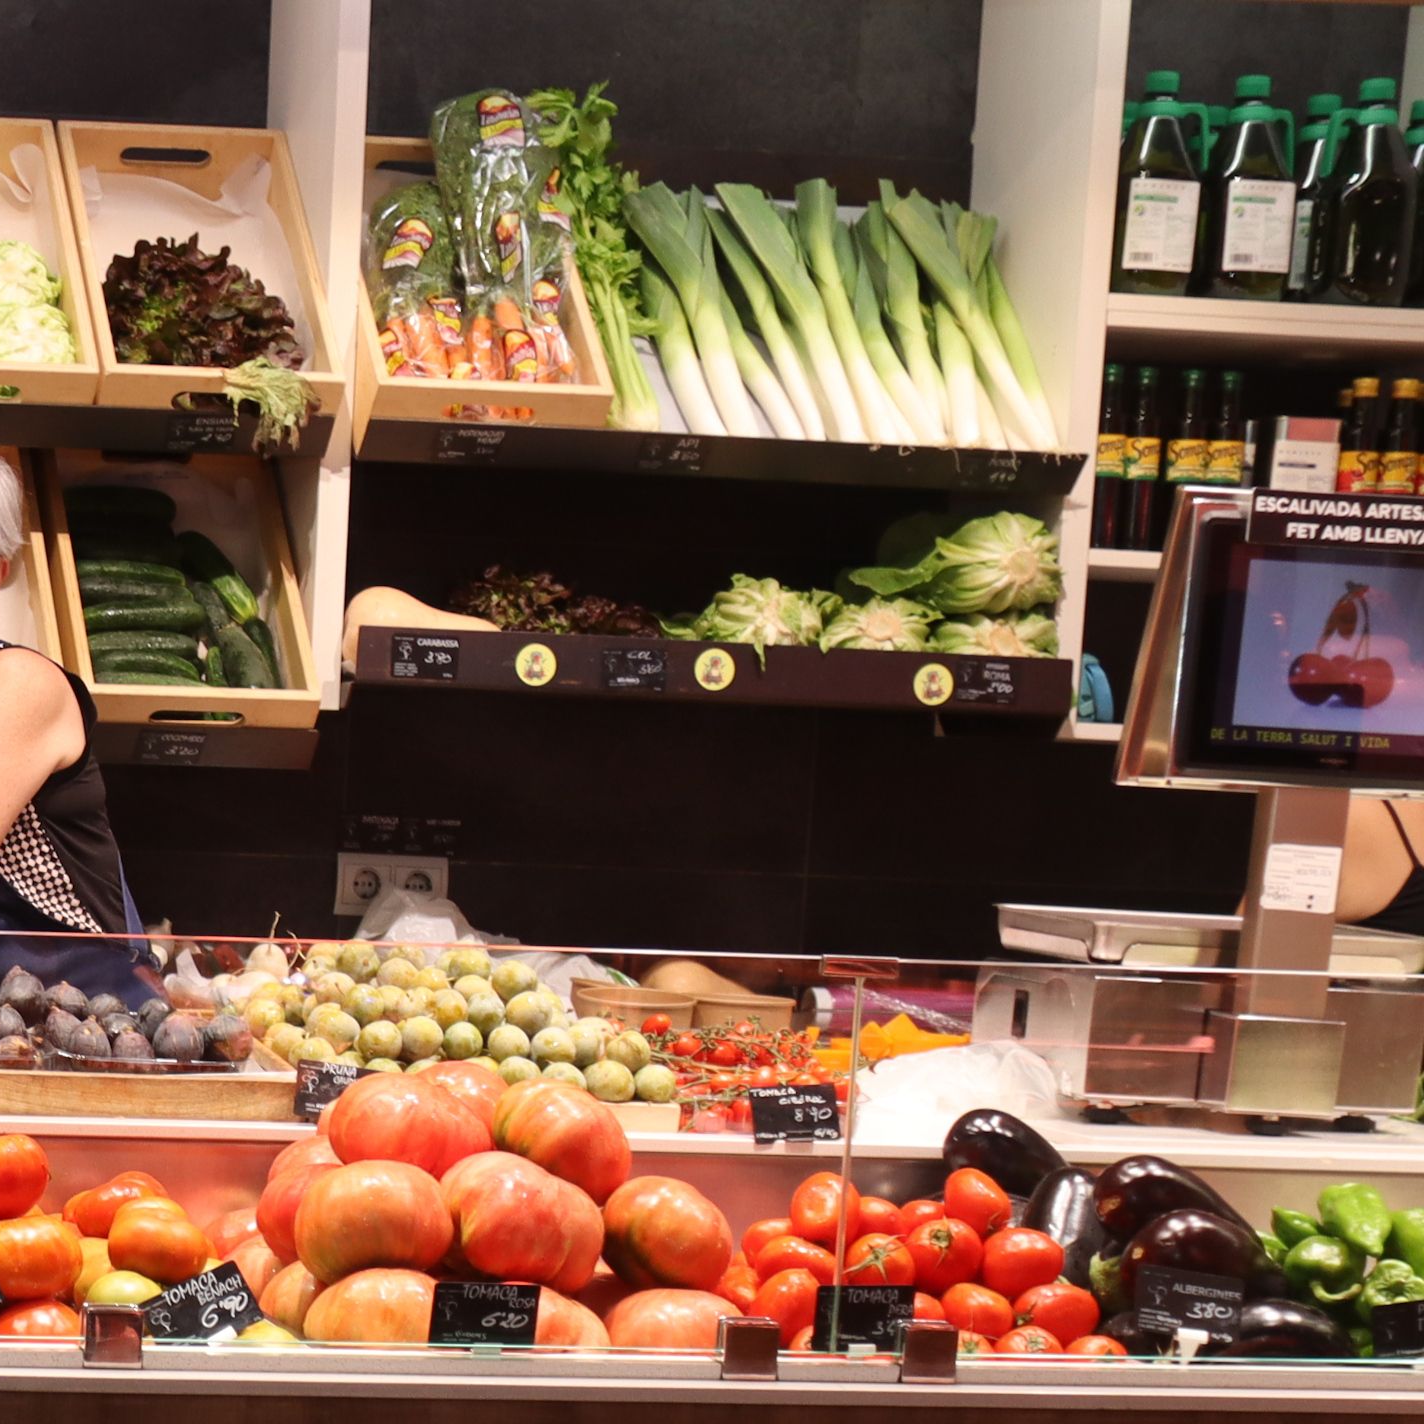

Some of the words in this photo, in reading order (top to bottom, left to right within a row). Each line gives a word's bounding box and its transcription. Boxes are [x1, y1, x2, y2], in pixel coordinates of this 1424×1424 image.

[1255, 495, 1361, 517] ESCALIVADA
[1365, 503, 1424, 521] ARTES
[1286, 521, 1319, 539] FET
[1320, 523, 1362, 541] AMB
[417, 638, 459, 648] CARABASSA
[627, 651, 652, 660] COL
[1210, 728, 1225, 740] DE
[1233, 729, 1248, 741] LA
[1256, 730, 1292, 743] TERRA
[1300, 733, 1337, 746] SALUT
[1345, 736, 1352, 747] I
[1359, 736, 1390, 749] VIDA
[322, 1062, 357, 1078] PRUNA
[750, 1086, 796, 1097] TOMACA
[162, 1271, 217, 1306] TOMACA
[463, 1284, 518, 1300] TOMACA
[848, 1288, 899, 1304] TOMACA
[508, 1297, 536, 1309] ROSA
